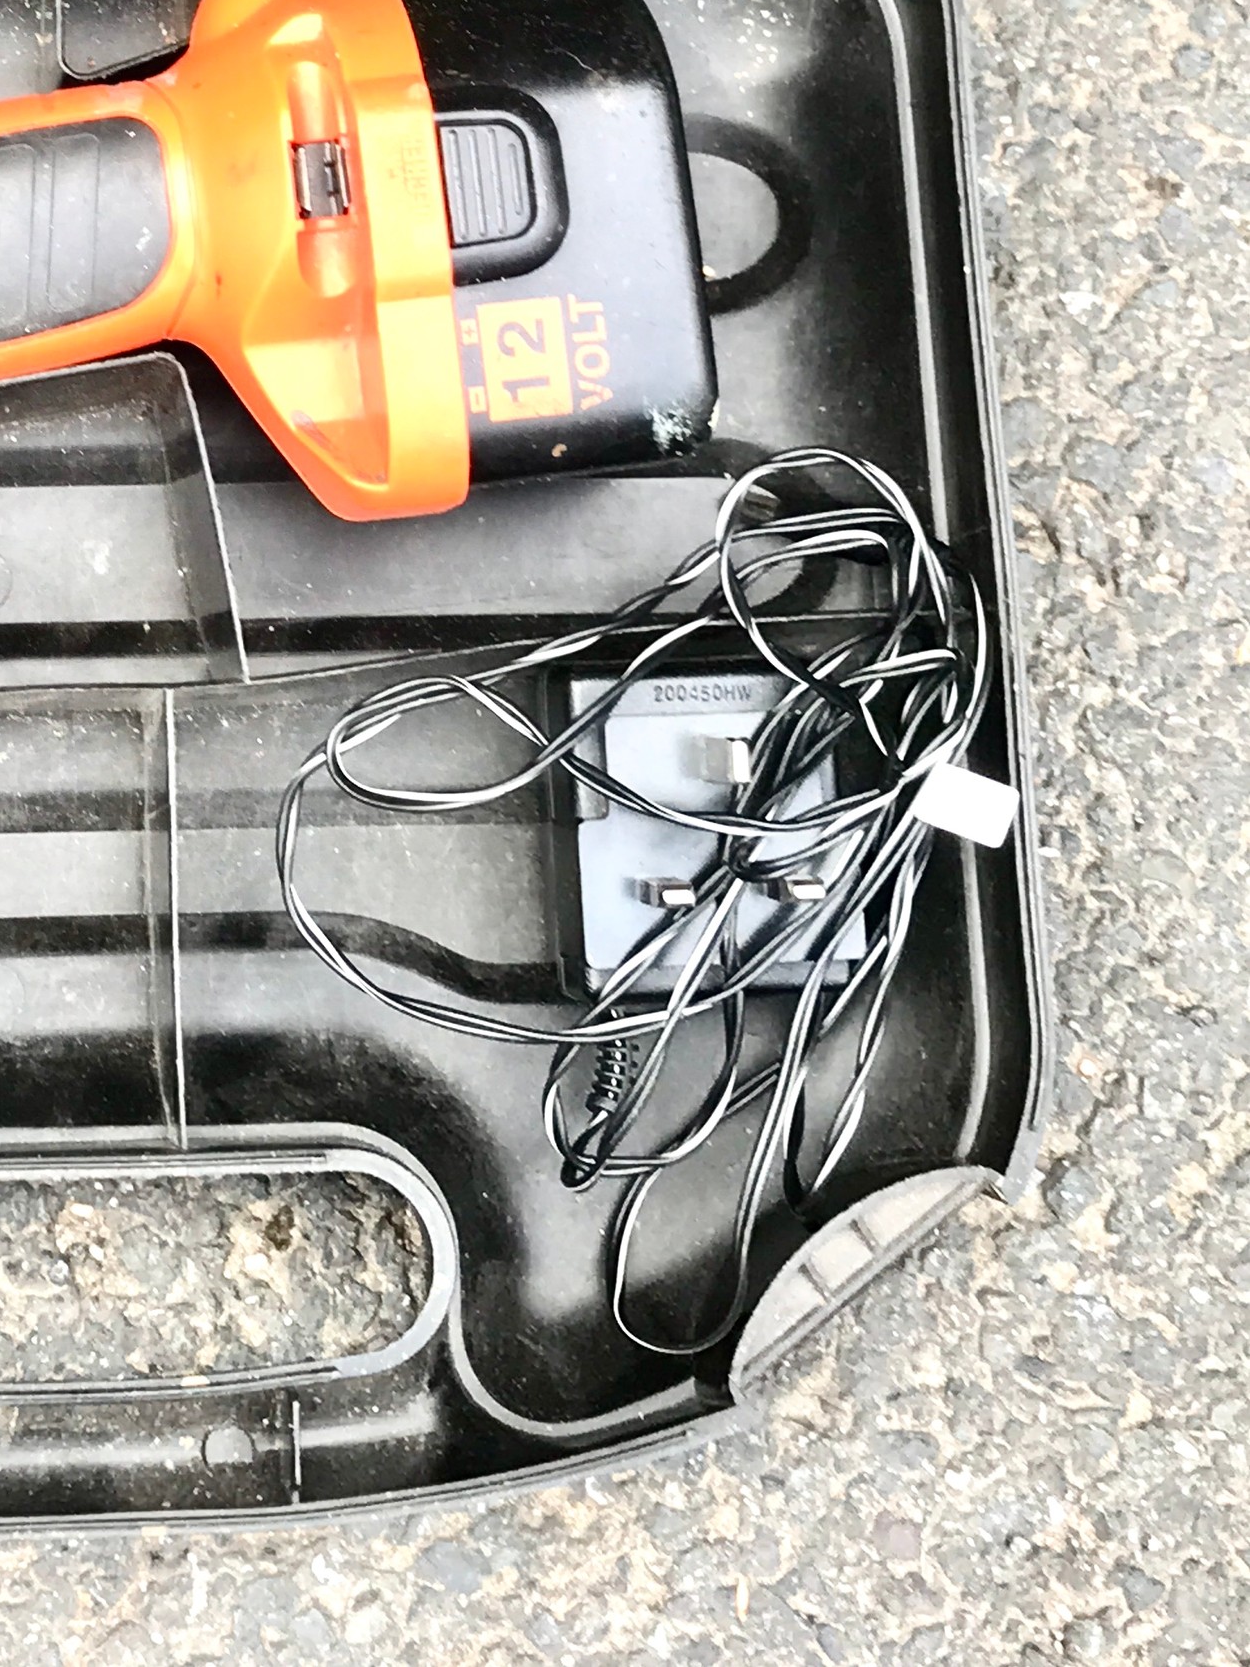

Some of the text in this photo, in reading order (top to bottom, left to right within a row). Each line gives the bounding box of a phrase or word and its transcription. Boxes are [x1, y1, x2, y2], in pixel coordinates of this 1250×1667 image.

[497, 318, 547, 403] 12
[567, 293, 614, 411] VOLT
[653, 684, 751, 702] 200450HW
